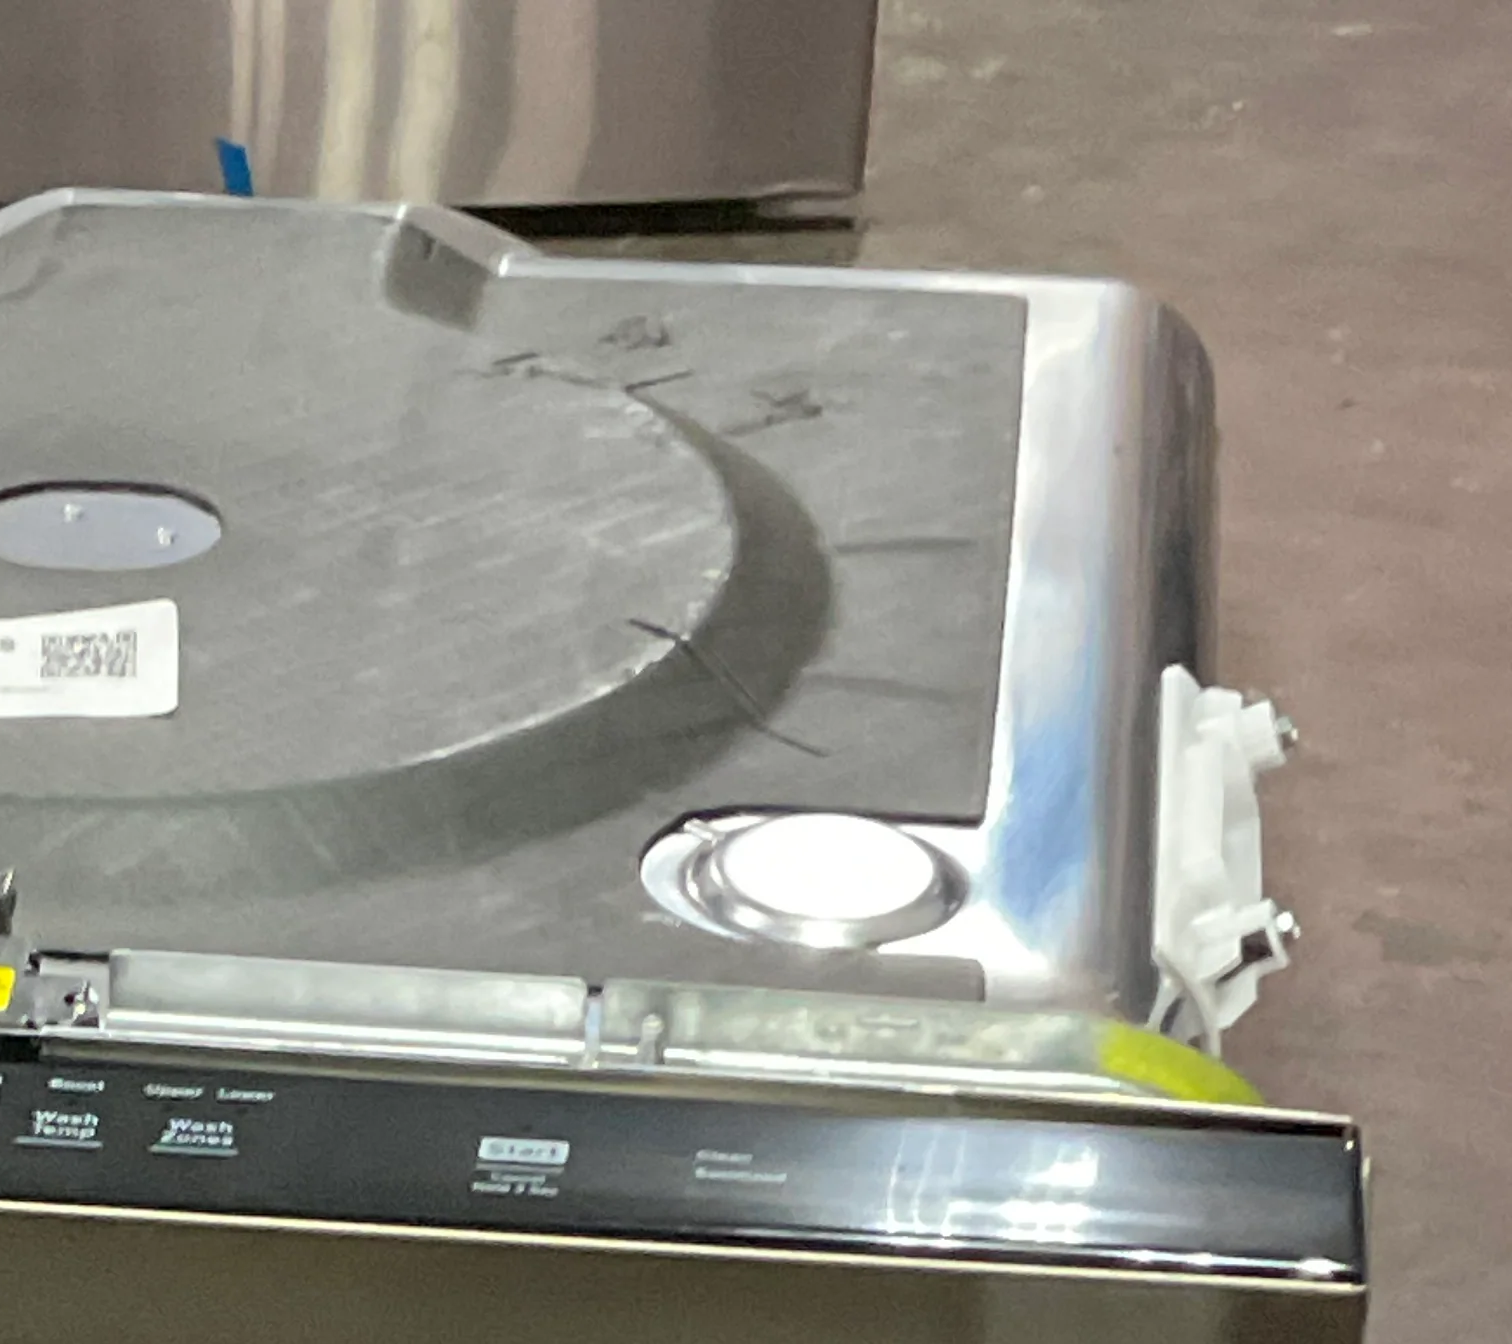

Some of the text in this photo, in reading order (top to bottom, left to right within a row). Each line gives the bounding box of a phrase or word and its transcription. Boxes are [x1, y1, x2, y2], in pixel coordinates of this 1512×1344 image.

[31, 1110, 100, 1126] Wash
[169, 1118, 234, 1134] Wash
[32, 1121, 96, 1140] Temp
[160, 1129, 234, 1147] Zones
[487, 1142, 558, 1159] Start
